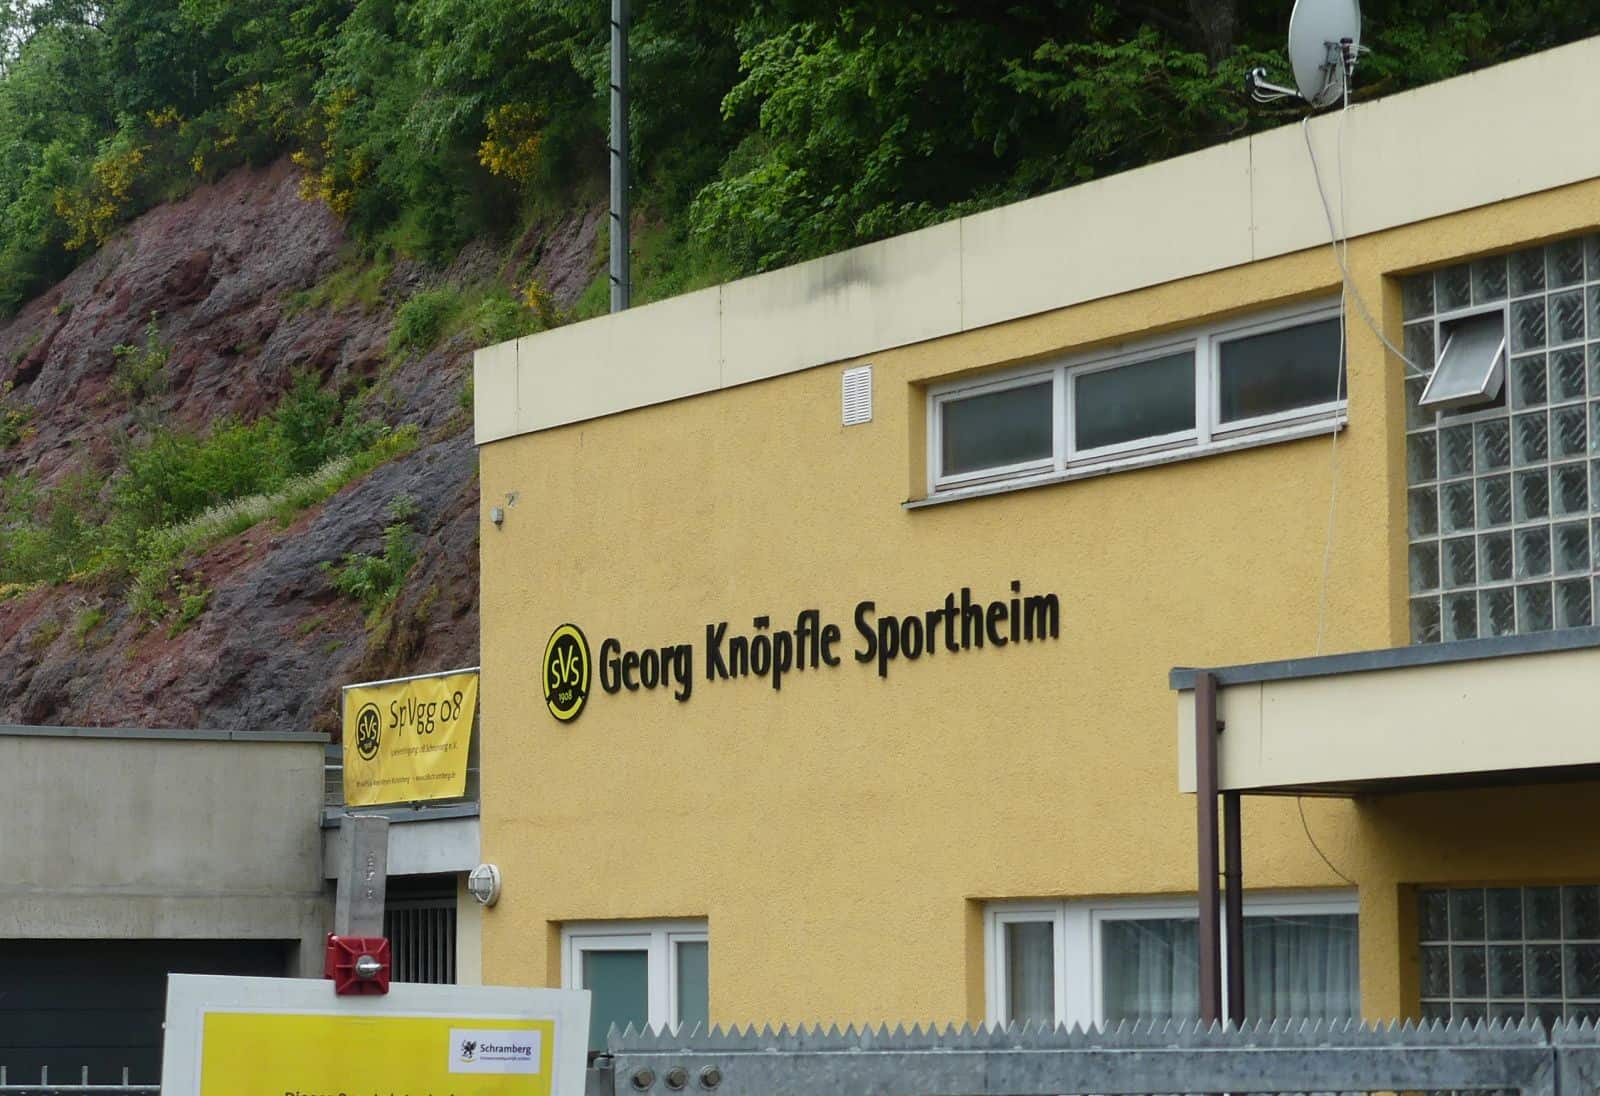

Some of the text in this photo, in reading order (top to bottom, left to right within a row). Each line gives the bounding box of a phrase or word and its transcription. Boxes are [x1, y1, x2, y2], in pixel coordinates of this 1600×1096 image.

[600, 580, 1059, 702] Georg Knöpfle Sportheim
[558, 689, 573, 704] 1908
[389, 691, 463, 736] SpVgg 08
[479, 1043, 531, 1056] Schramberg
